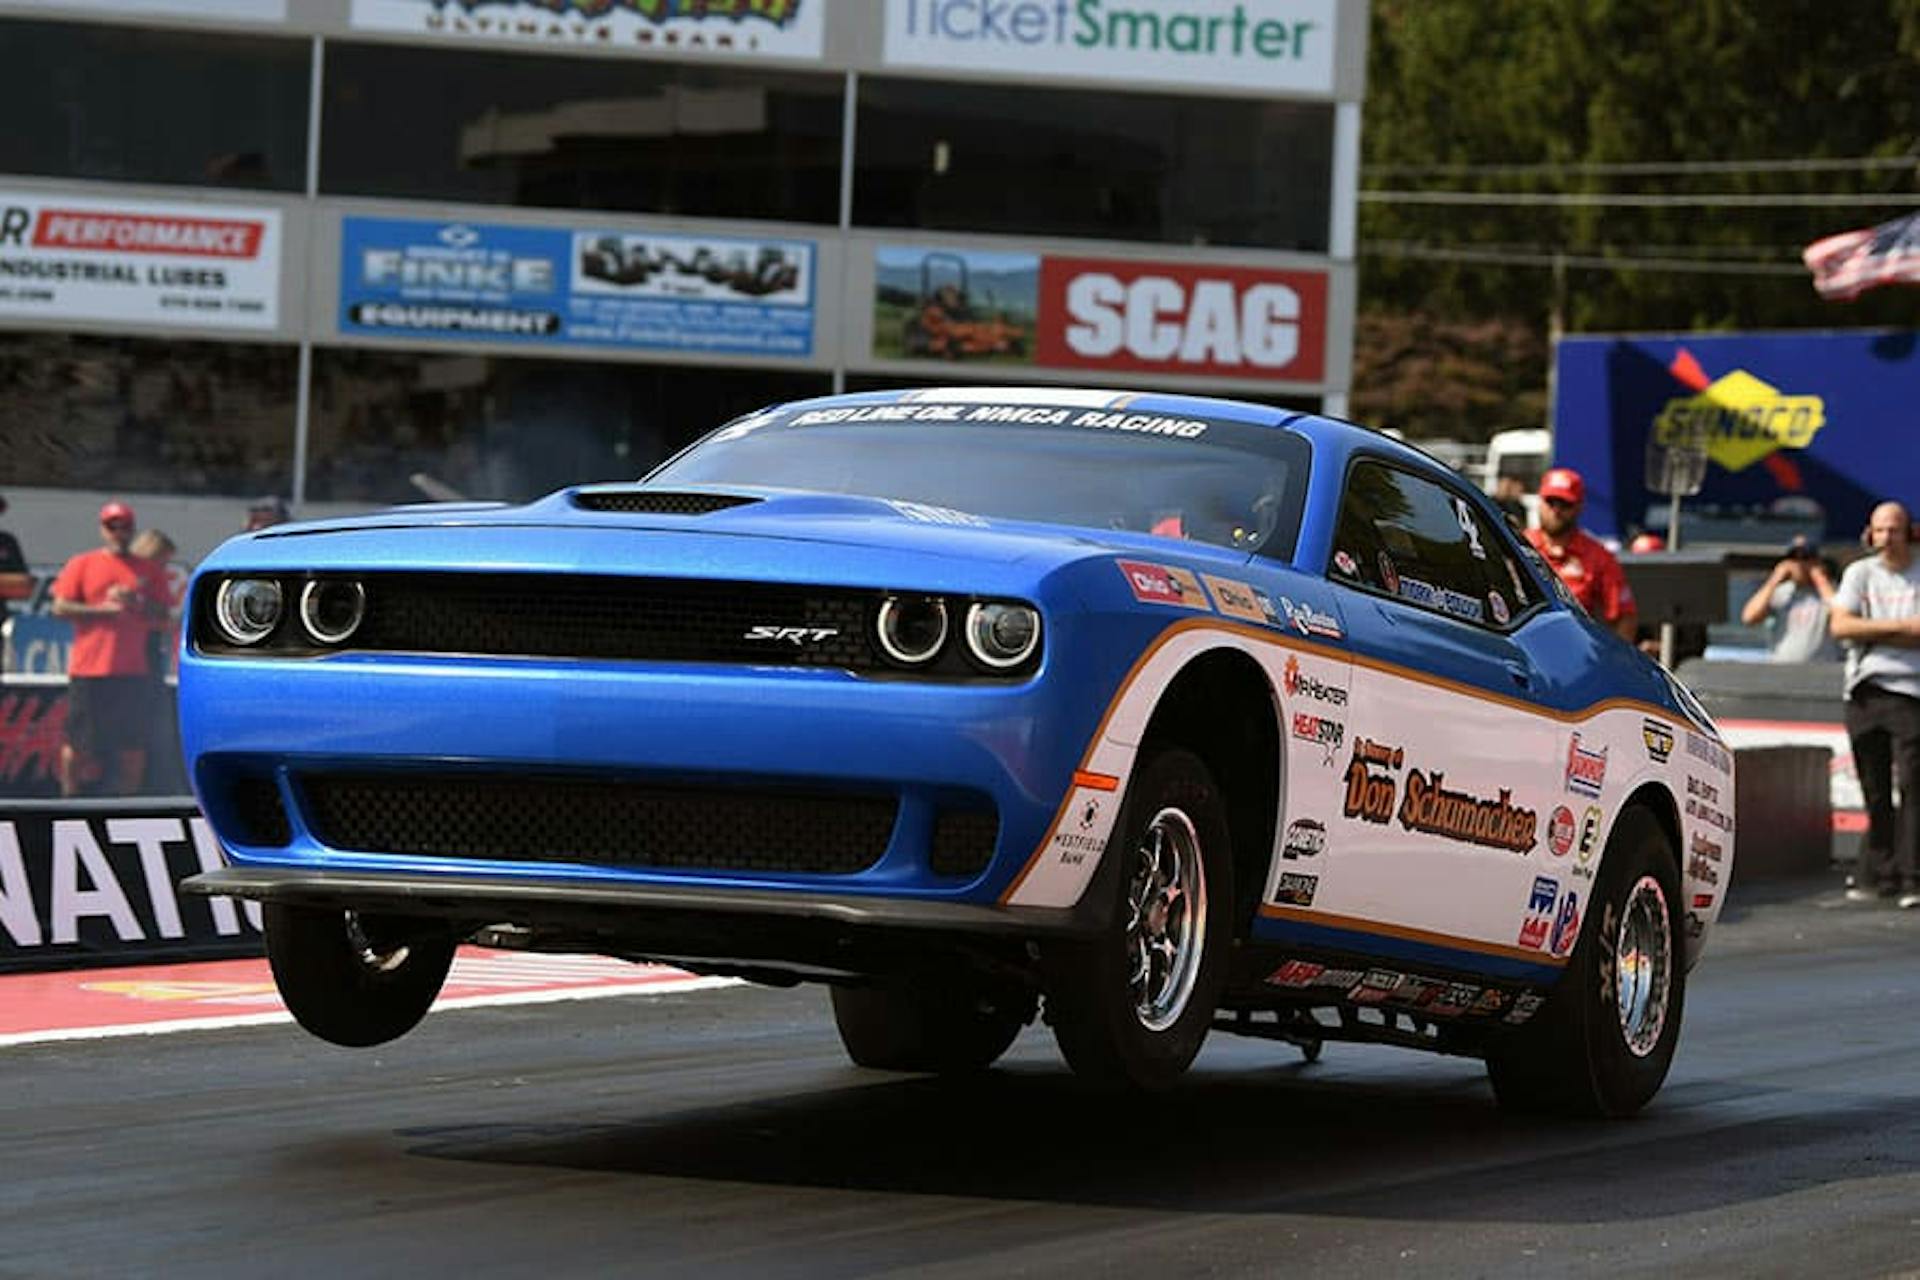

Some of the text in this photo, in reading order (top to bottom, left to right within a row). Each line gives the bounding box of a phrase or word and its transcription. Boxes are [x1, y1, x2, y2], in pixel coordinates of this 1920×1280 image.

[902, 0, 1313, 59] TicketSmarter
[46, 214, 248, 255] PERFORMANCE
[149, 265, 227, 288] LUBES
[363, 249, 554, 292] FINKE
[359, 305, 551, 334] EQUIPMENT
[1064, 272, 1301, 368] SCAG
[964, 404, 1069, 425] NMCA
[1073, 409, 1208, 440] RACING
[1664, 405, 1814, 440] SUNOCO
[743, 625, 839, 646] SRT
[1345, 758, 1396, 824] Don
[1400, 768, 1537, 855] Schumacher
[0, 817, 262, 947] NATI
